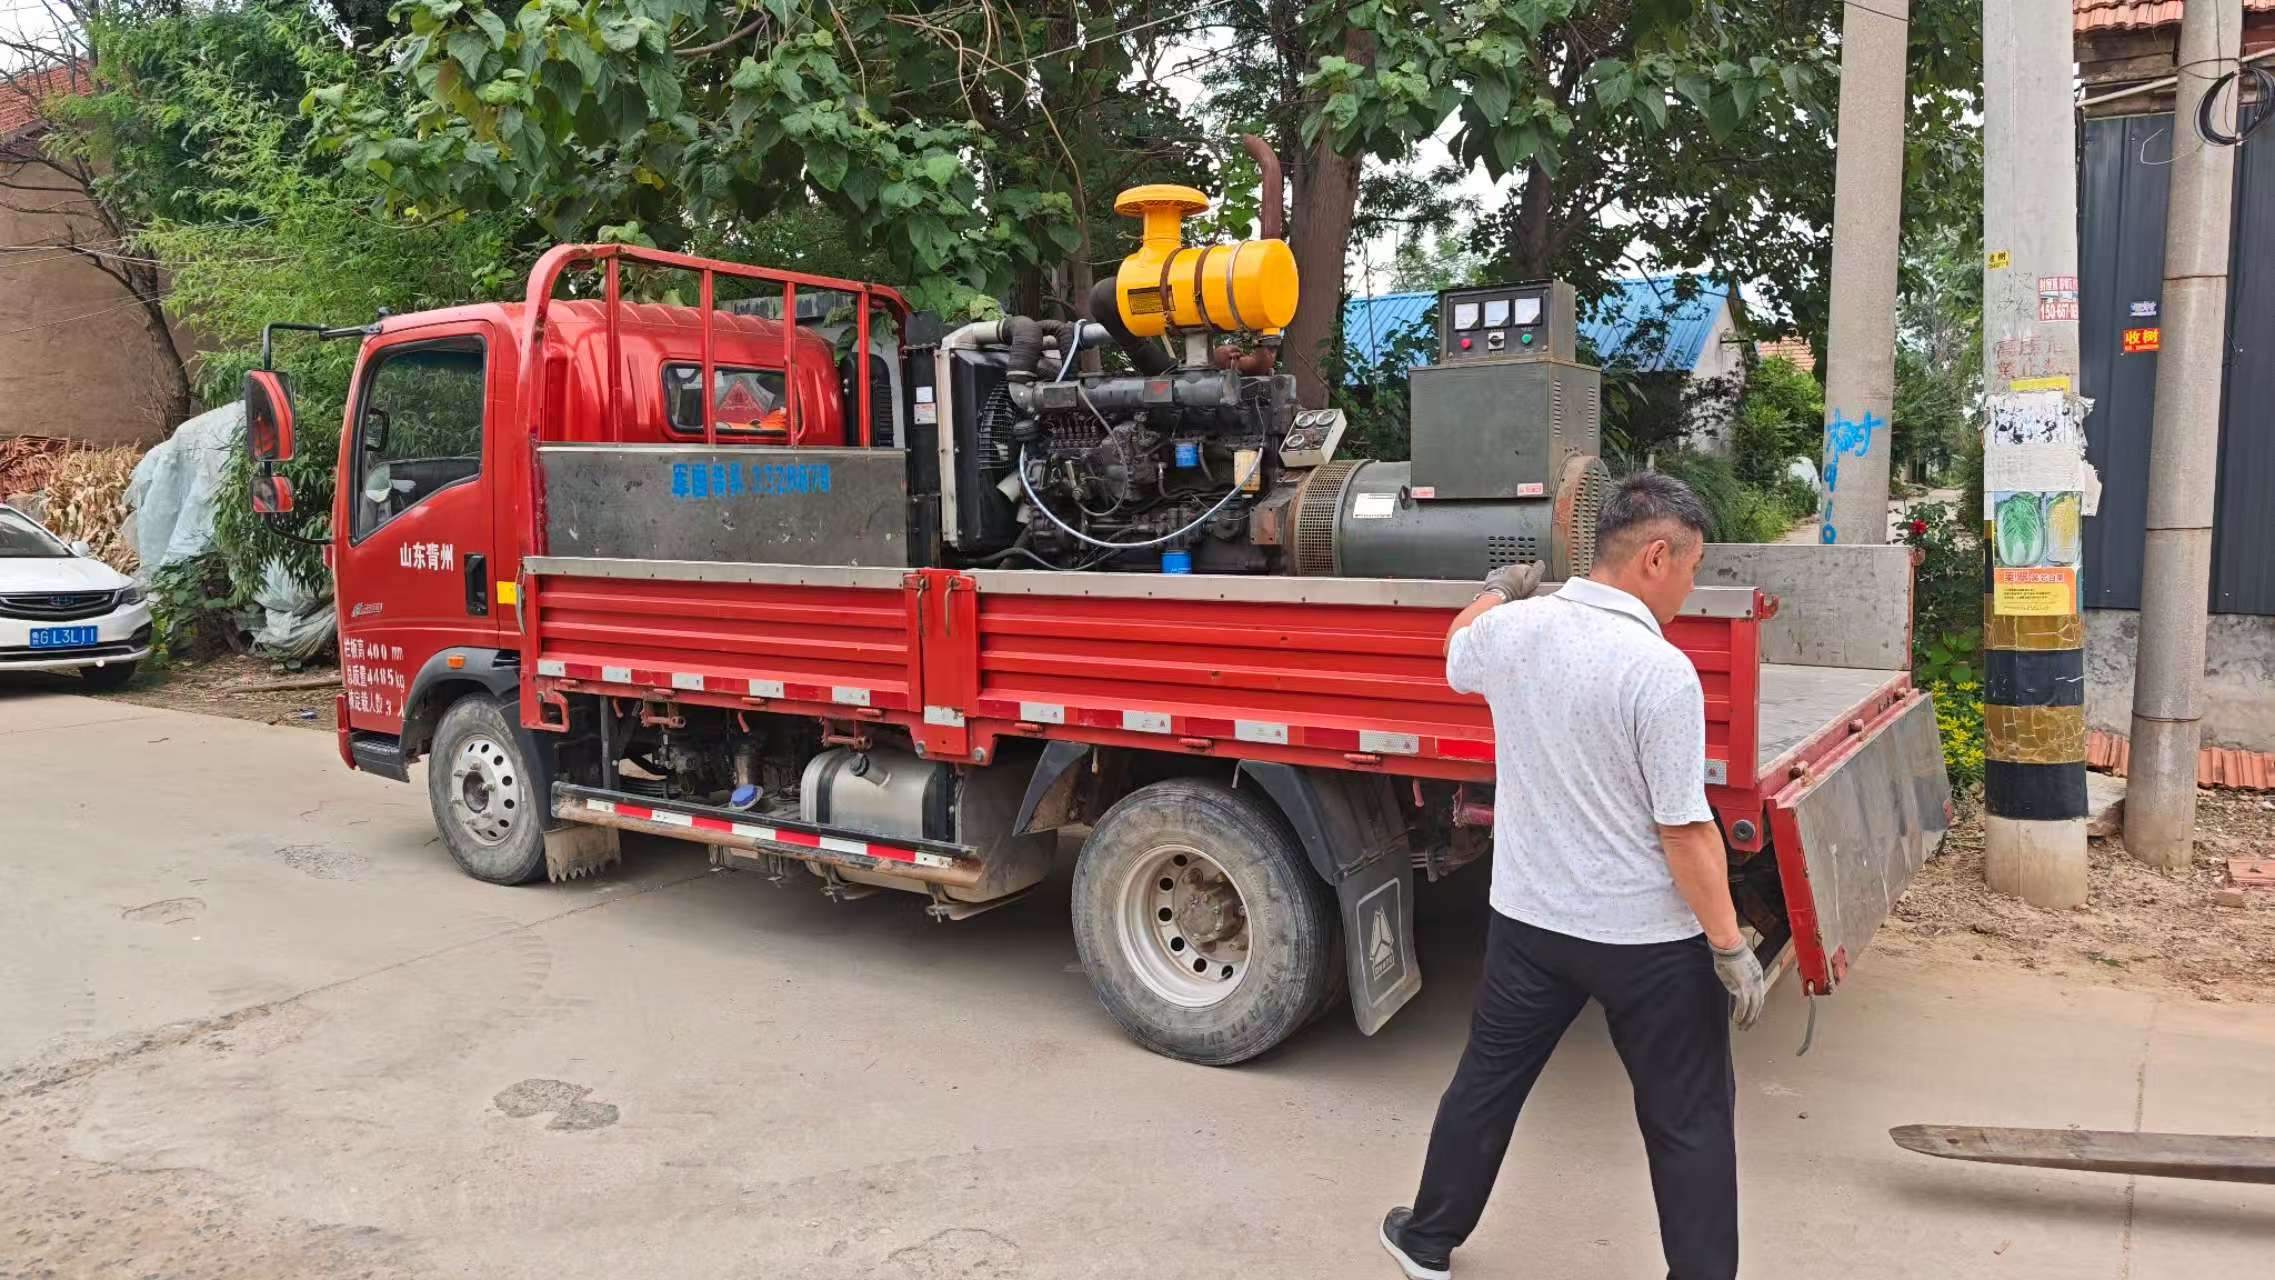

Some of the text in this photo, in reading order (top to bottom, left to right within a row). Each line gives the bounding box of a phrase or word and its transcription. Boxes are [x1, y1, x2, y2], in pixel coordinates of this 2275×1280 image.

[399, 541, 454, 571] 山东青州
[367, 642, 388, 661] 400
[385, 700, 392, 716] 3
